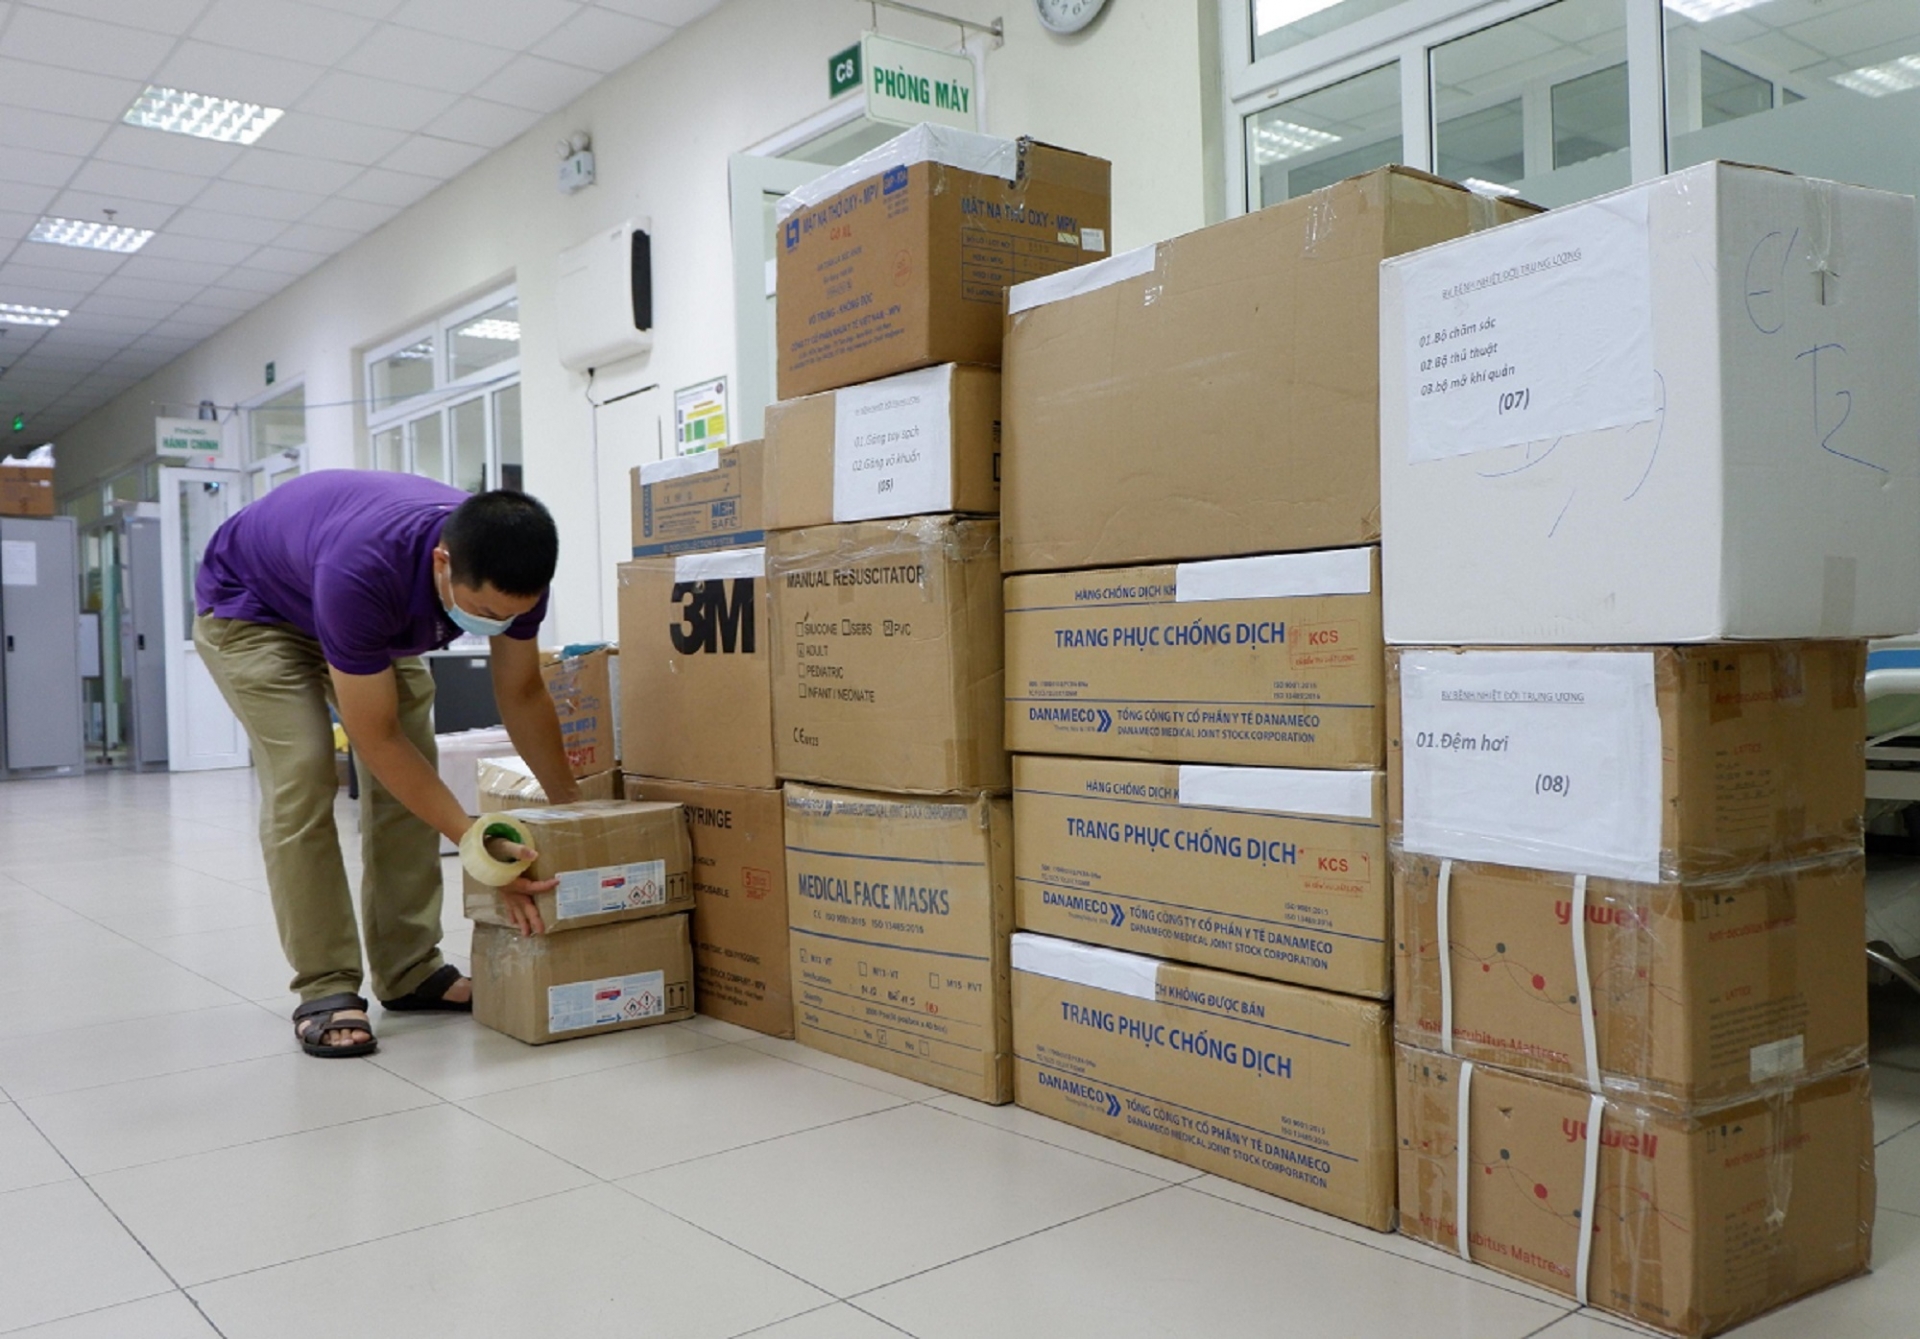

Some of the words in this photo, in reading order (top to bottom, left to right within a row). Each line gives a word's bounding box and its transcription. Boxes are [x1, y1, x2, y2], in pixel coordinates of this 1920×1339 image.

[836, 59, 854, 83] C8
[873, 65, 930, 105] PHÒNG
[934, 79, 969, 113] MÁY
[1028, 210, 1049, 227] OXY
[1056, 214, 1078, 232] MPV
[1498, 387, 1530, 415] (07)
[786, 571, 830, 588] MANUAL
[833, 565, 925, 587] RESUSCITATOR
[1074, 588, 1101, 601] HÀNG
[1102, 585, 1136, 599] CHỐNG
[1139, 586, 1161, 600] DỊCH
[669, 578, 756, 655] 3M
[850, 623, 872, 635] SEBS
[894, 623, 911, 635] PVC
[1054, 628, 1108, 649] TRANG
[1113, 626, 1160, 652] PHỤC
[1163, 617, 1231, 646] CHỐNG
[1235, 622, 1285, 650] DỊCH
[1308, 630, 1339, 645] KCS
[806, 645, 828, 657] ADULT
[806, 665, 844, 679] PEDIATRIC
[1029, 707, 1095, 722] DANAMECO
[1117, 707, 1143, 721] TỔNG
[1145, 708, 1171, 723] CÔNG
[1173, 711, 1184, 723] TY
[1186, 710, 1200, 723] CỔ
[1202, 709, 1233, 724] PHẦN
[1233, 713, 1238, 724] Y
[1241, 710, 1253, 725] TẾ
[1256, 713, 1320, 728] DANAMECO
[1117, 726, 1160, 737] DANAMECO
[1161, 727, 1195, 738] MEDICAL
[1197, 729, 1220, 739] JOINT
[1222, 729, 1250, 740] STOCK
[1250, 731, 1315, 743] CORPORATION
[1416, 732, 1476, 752] 01.Đệm
[1480, 734, 1509, 751] hơi
[1086, 780, 1112, 793] HÀNG
[1113, 781, 1146, 797] CHỐNG
[1148, 786, 1171, 801] DỊCH
[1535, 773, 1570, 797] (08)
[683, 805, 732, 829] SYRINGE
[1067, 817, 1119, 842] TRANG
[1124, 824, 1170, 852] PHỤC
[1174, 827, 1242, 858] CHỐNG
[1247, 838, 1296, 867] DỊCH
[1318, 857, 1349, 872] KCS
[798, 873, 852, 905] MEDICAL
[853, 881, 890, 910] FACE
[893, 886, 950, 916] MASKS
[1042, 890, 1108, 915] DANAMECO
[1129, 905, 1155, 921] TỔNG
[1156, 909, 1183, 926] CÔNG
[1184, 916, 1197, 928] TY
[1199, 917, 1212, 932] CỔ
[1214, 918, 1242, 939] PHẦN
[1244, 927, 1251, 939] Y
[1252, 926, 1265, 943] TẾ
[1268, 931, 1333, 955] DANAMECO
[1554, 901, 1649, 930] ywell
[1130, 923, 1173, 939] DANAMECO
[1173, 928, 1208, 946] MEDICAL
[1210, 938, 1232, 951] JOINT
[1235, 943, 1262, 957] STOCK
[1264, 948, 1328, 970] CORPORATION
[1168, 986, 1206, 1005] KHÔNG
[1207, 993, 1239, 1014] ĐƯỢC
[1241, 1002, 1266, 1018] BÁN
[1061, 1001, 1114, 1033] TRANG
[1118, 1016, 1165, 1048] PHỤC
[1169, 1029, 1237, 1065] CHỐNG
[1242, 1046, 1292, 1079] DỊCH
[1509, 1038, 1569, 1063] Mattress
[1038, 1071, 1104, 1103] DANAMECO
[1126, 1096, 1151, 1116] TỔNG
[1153, 1102, 1180, 1126] CÔNG
[1181, 1115, 1194, 1129] TY
[1195, 1116, 1209, 1135] CỔ
[1211, 1121, 1241, 1145] PHẦN
[1241, 1134, 1249, 1148] Y
[1250, 1135, 1263, 1152] TẾ
[1264, 1143, 1331, 1174] DANAMECO
[1127, 1115, 1170, 1137] DANAMECO
[1171, 1127, 1206, 1148] MEDICAL
[1207, 1140, 1231, 1157] JOINT
[1233, 1148, 1260, 1166] STOCK
[1262, 1157, 1328, 1189] CORPORATION
[1510, 1244, 1571, 1279] Mattress
